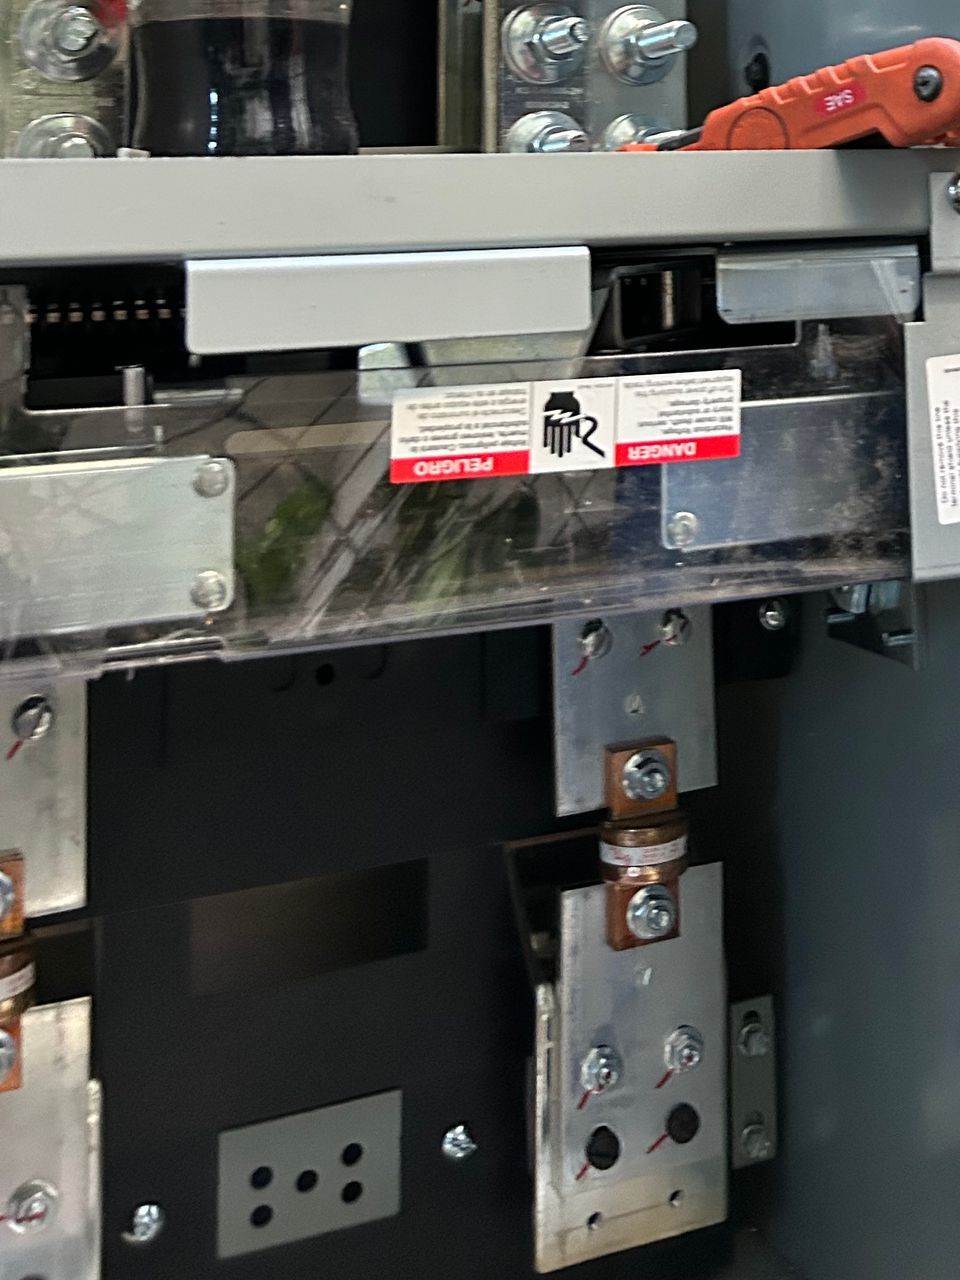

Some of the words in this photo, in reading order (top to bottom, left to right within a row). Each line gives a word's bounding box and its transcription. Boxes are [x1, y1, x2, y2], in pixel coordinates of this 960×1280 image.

[823, 89, 855, 112] SAE
[627, 441, 696, 460] DANGER
[412, 455, 494, 477] PELIGRO
